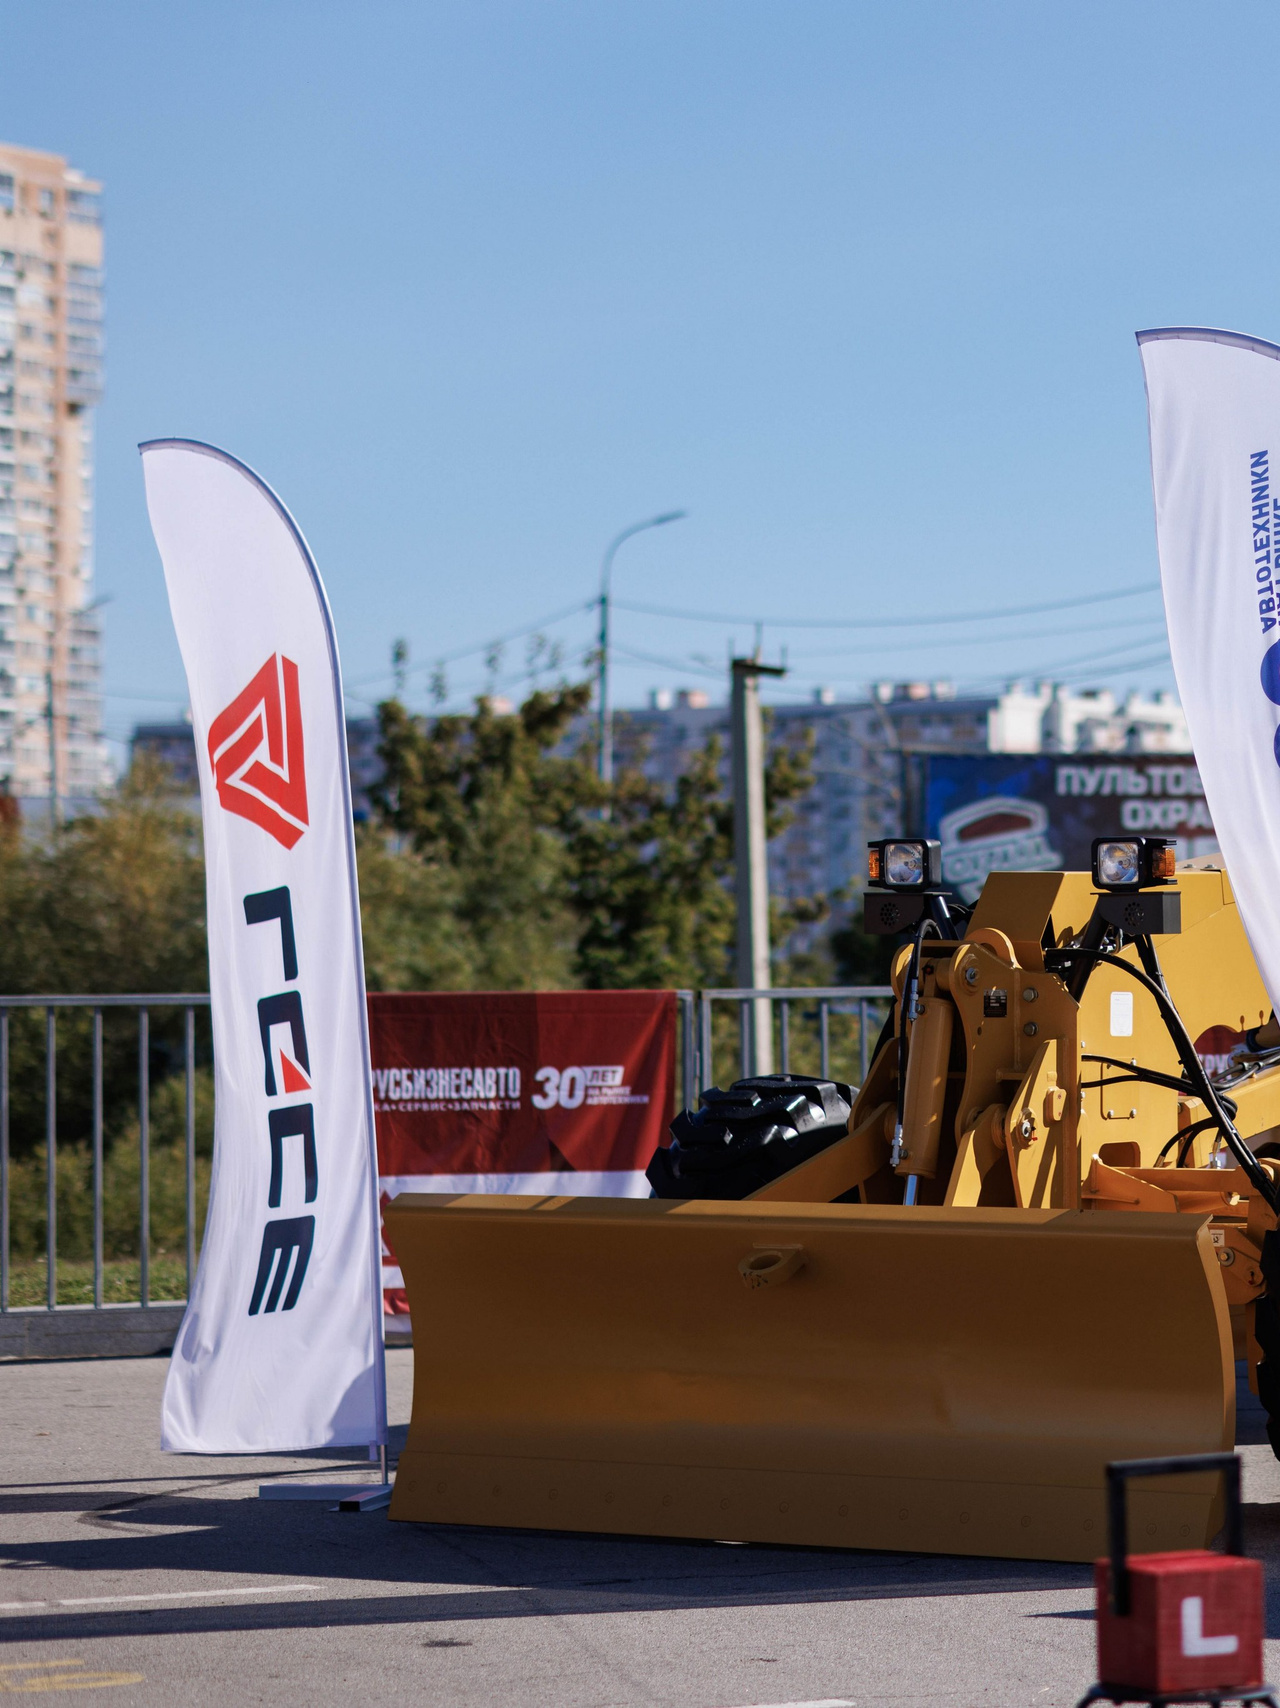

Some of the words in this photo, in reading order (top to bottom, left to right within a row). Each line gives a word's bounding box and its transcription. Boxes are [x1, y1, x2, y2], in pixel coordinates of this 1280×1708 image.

[531, 1065, 586, 1110] 30
[588, 1069, 619, 1082] ЛЕТ
[1181, 1596, 1239, 1658] L
